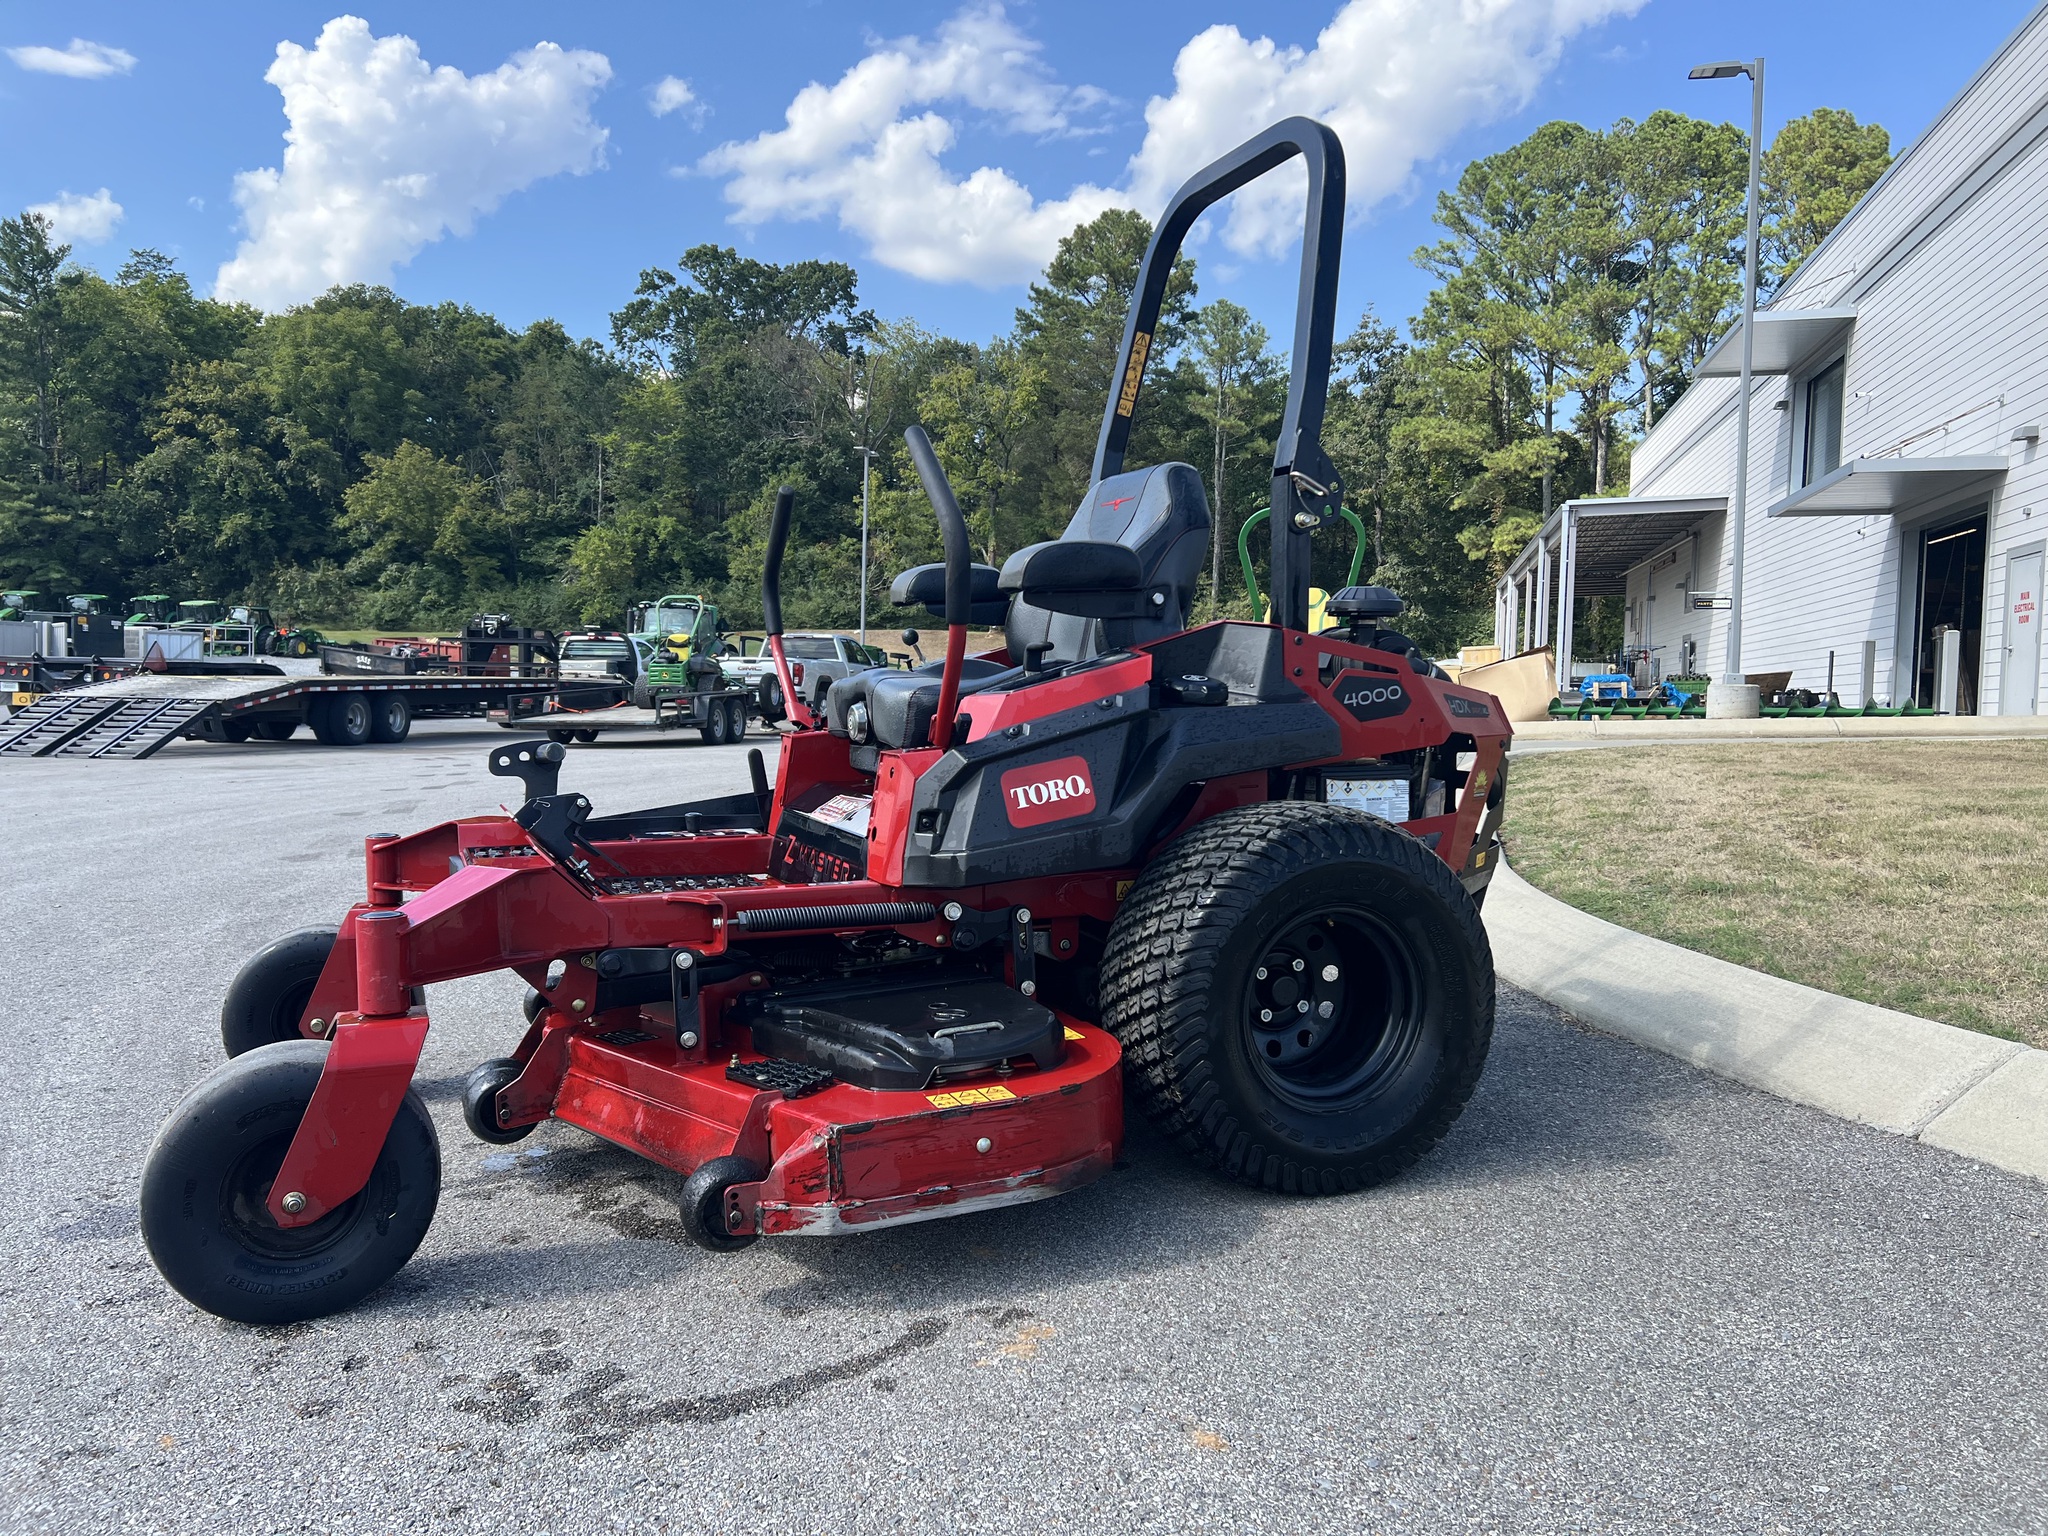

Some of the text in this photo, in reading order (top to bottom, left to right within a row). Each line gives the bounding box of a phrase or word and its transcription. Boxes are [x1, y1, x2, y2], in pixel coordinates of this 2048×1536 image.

[2020, 591, 2030, 600] MAIN
[2014, 602, 2035, 613] ELECTRICAL
[2018, 615, 2029, 624] ROOM
[1343, 685, 1402, 707] 4000
[1448, 700, 1471, 713] HDX
[1010, 775, 1086, 810] TORO
[784, 834, 850, 881] Z MASTER
